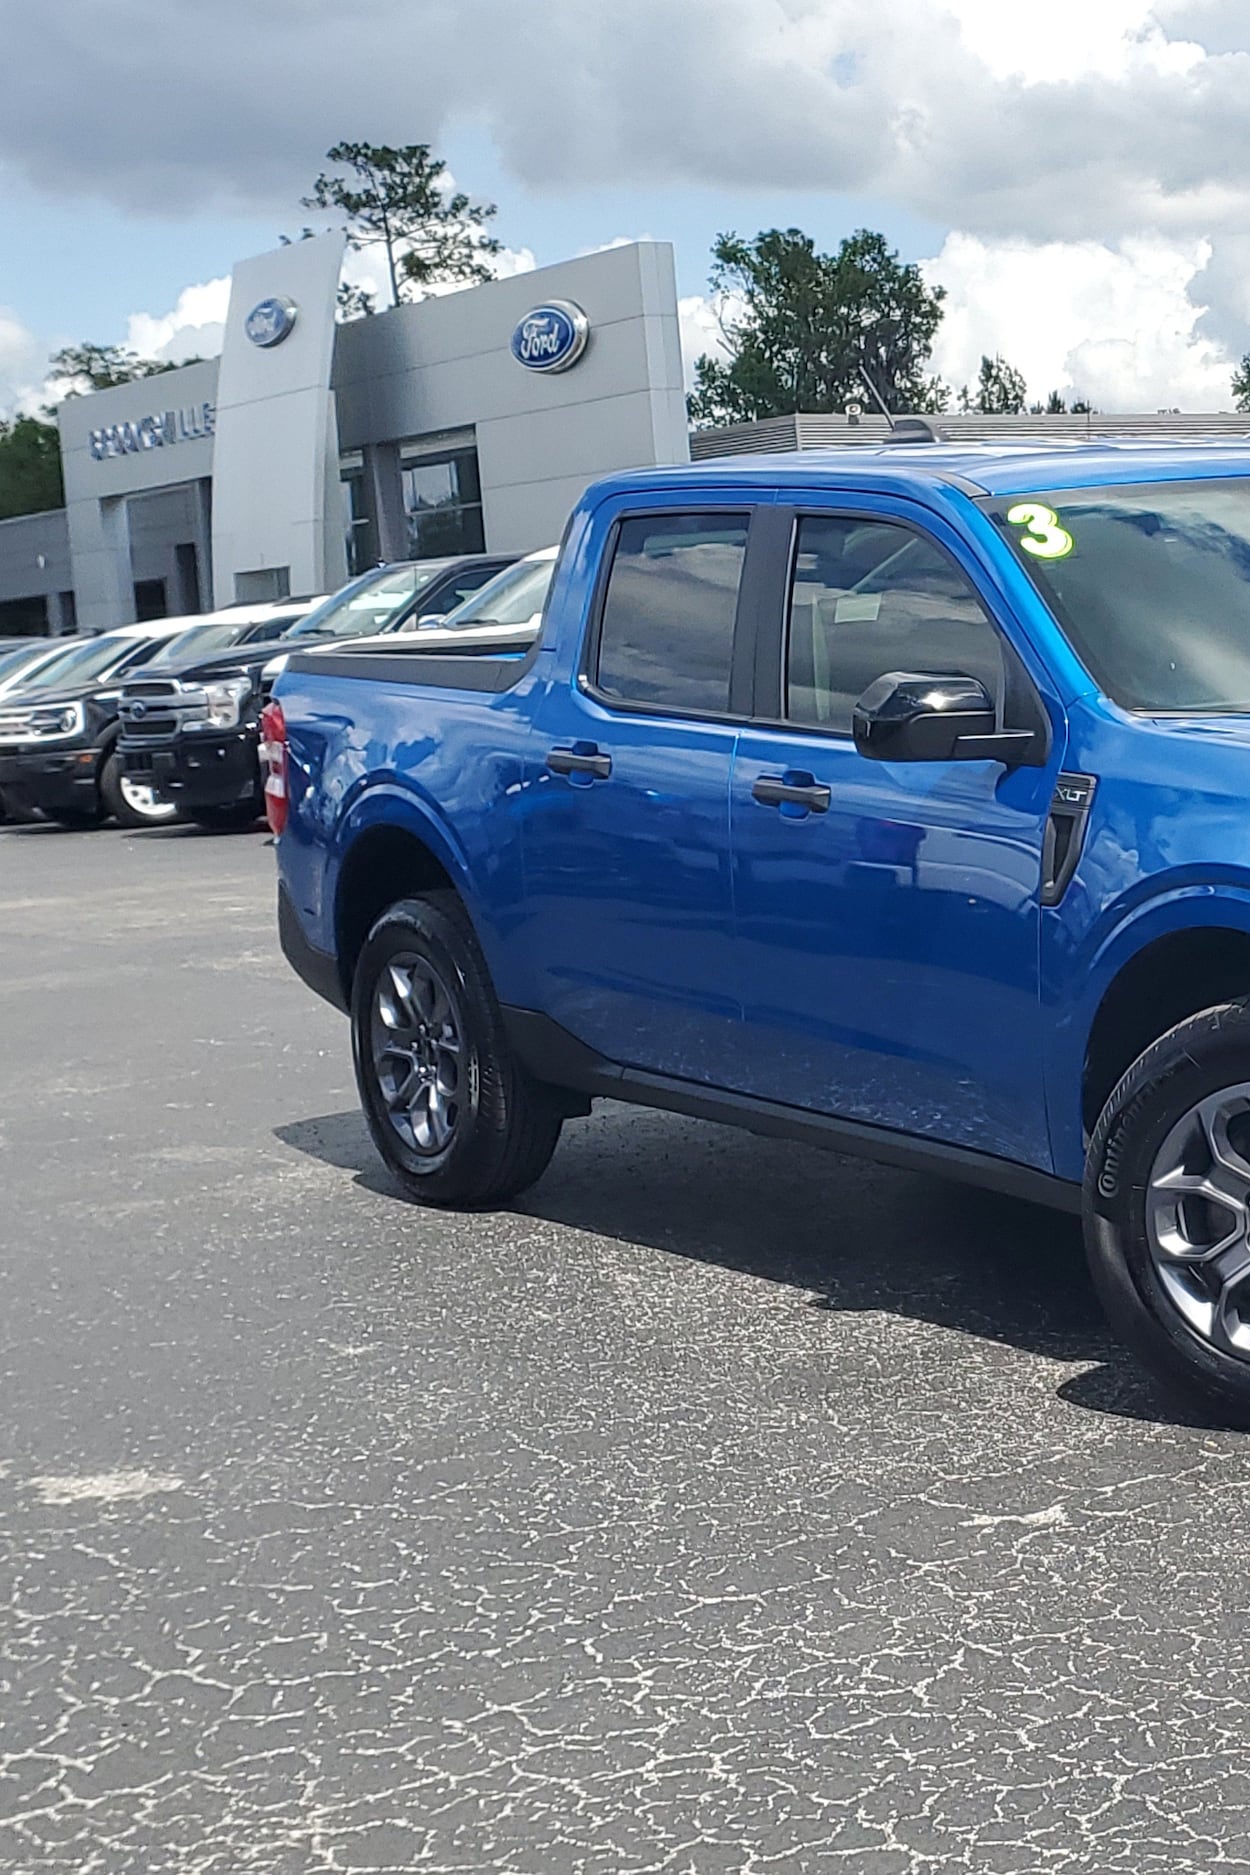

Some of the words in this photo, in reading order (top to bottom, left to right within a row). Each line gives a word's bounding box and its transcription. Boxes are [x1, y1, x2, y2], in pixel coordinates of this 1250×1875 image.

[520, 318, 560, 359] Ford
[1007, 502, 1074, 559] 3
[1055, 786, 1088, 802] XLT
